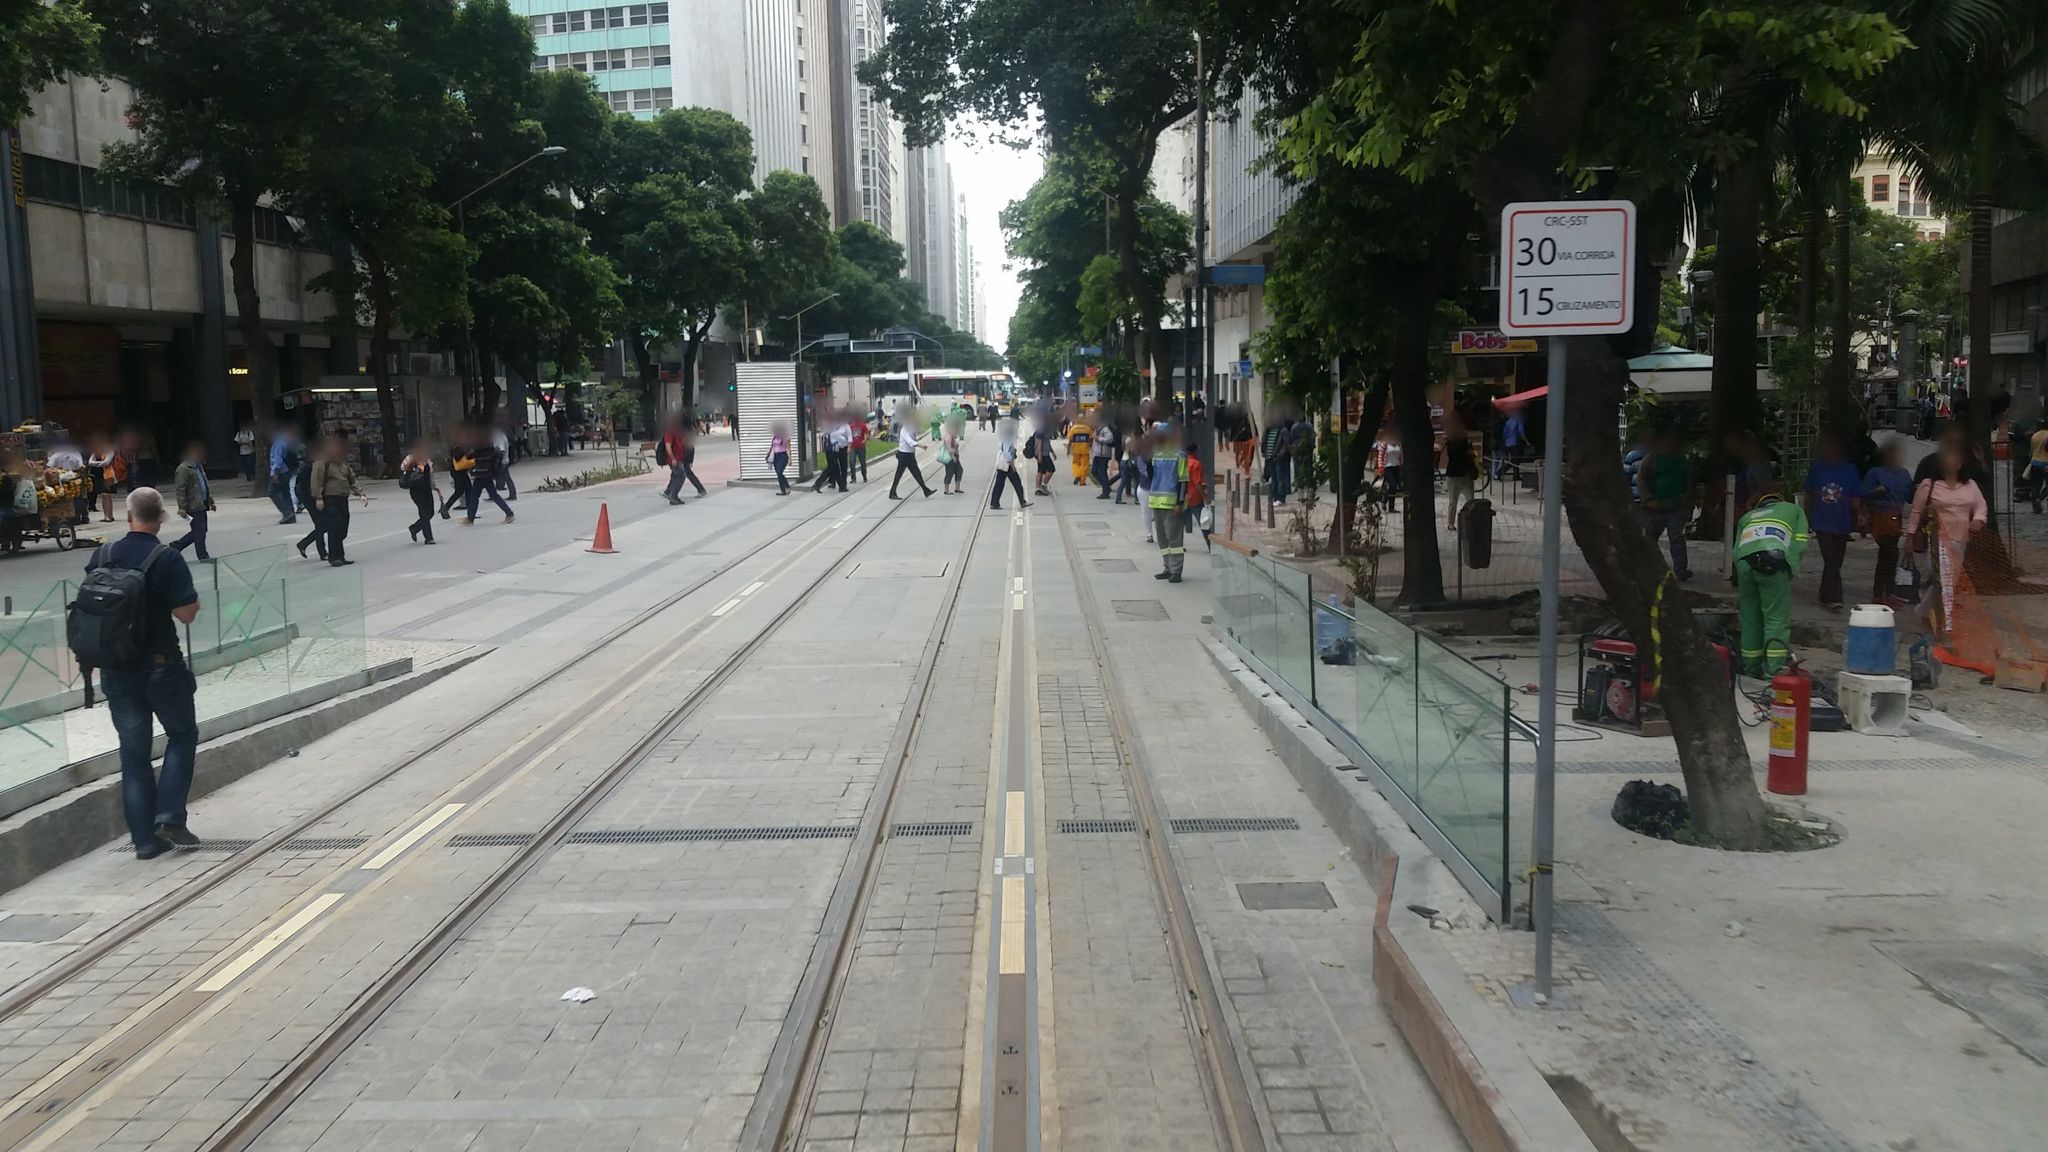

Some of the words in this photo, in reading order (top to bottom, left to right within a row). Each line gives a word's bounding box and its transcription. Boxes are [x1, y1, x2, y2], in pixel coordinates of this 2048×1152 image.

[1544, 215, 1589, 229] CRC-SST
[1516, 237, 1557, 267] 30
[1557, 251, 1573, 261] VIA
[1574, 250, 1616, 261] CORRIDA
[1518, 287, 1555, 316] 15
[1555, 300, 1622, 312] CRUZAMENTO
